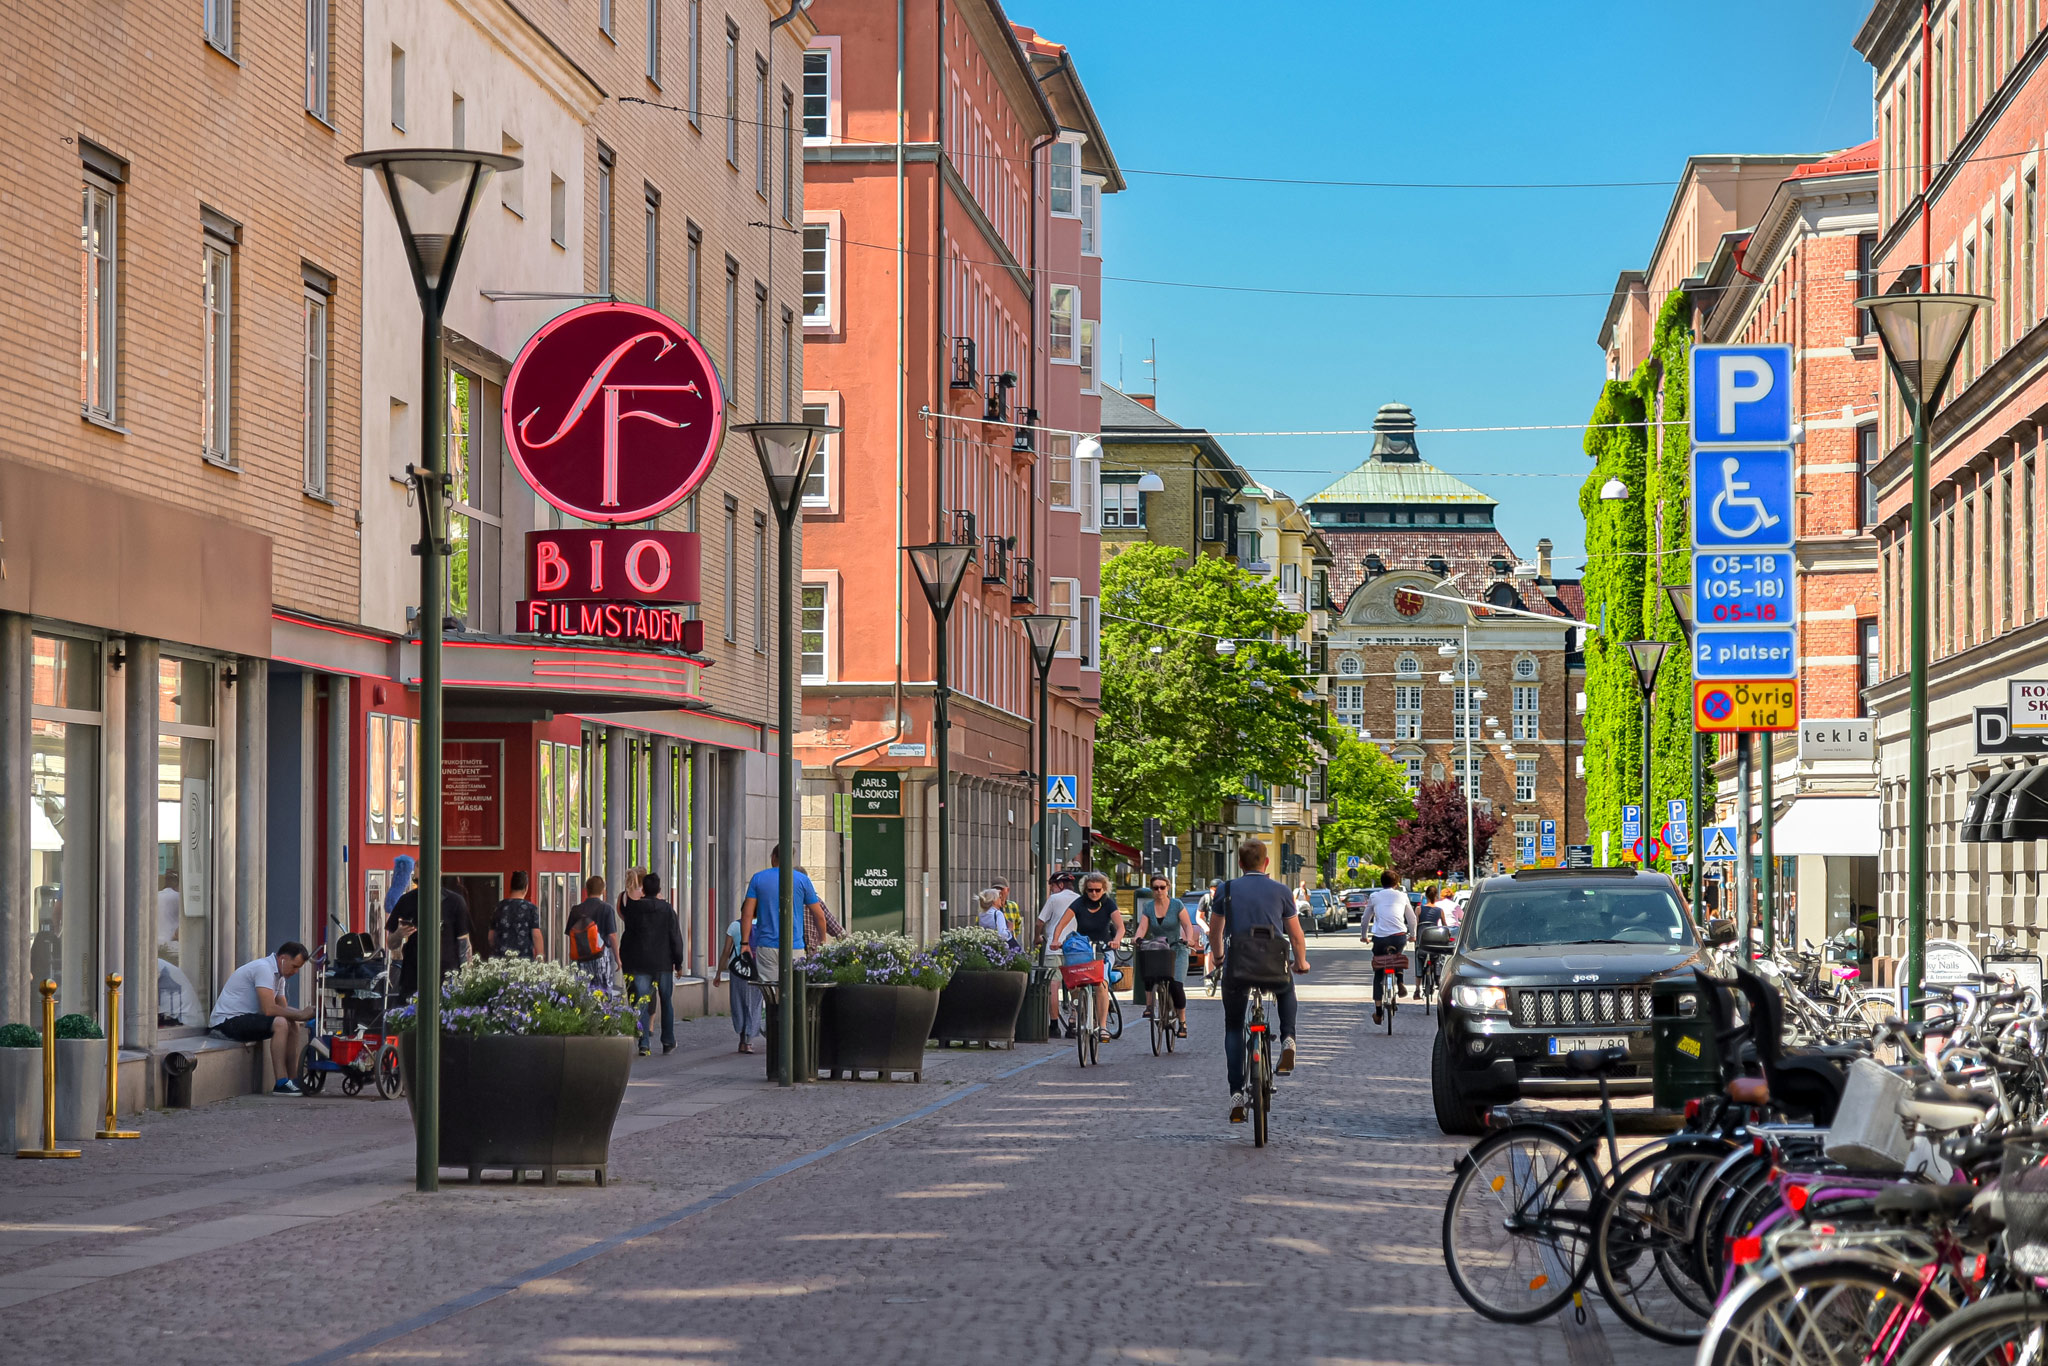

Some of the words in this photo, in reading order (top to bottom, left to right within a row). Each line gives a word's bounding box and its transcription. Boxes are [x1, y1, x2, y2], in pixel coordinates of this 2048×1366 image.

[1719, 355, 1775, 434] P
[537, 539, 672, 594] BIO
[1713, 557, 1776, 573] 05-18
[1704, 579, 1785, 599] (05-18)
[1713, 605, 1777, 621] 05-18
[529, 601, 683, 643] FILMSTADEN
[1376, 637, 1404, 646] PETRI
[1700, 645, 1712, 660] 2
[1720, 644, 1791, 665] platser
[1735, 684, 1794, 708] Övrig
[1752, 709, 1778, 726] tid
[1804, 729, 1868, 743] tekla
[861, 778, 887, 788] JARLS
[851, 788, 899, 799] HÄLSOKOST
[457, 803, 483, 811] MÄSSA
[1627, 807, 1637, 821] P
[1673, 802, 1683, 820] P
[1544, 821, 1553, 833] P
[1525, 837, 1533, 847] P
[864, 869, 888, 877] JARLS
[854, 877, 898, 887] HÄLSOKOST
[1926, 961, 1937, 970] ky
[1938, 961, 1960, 970] Nails
